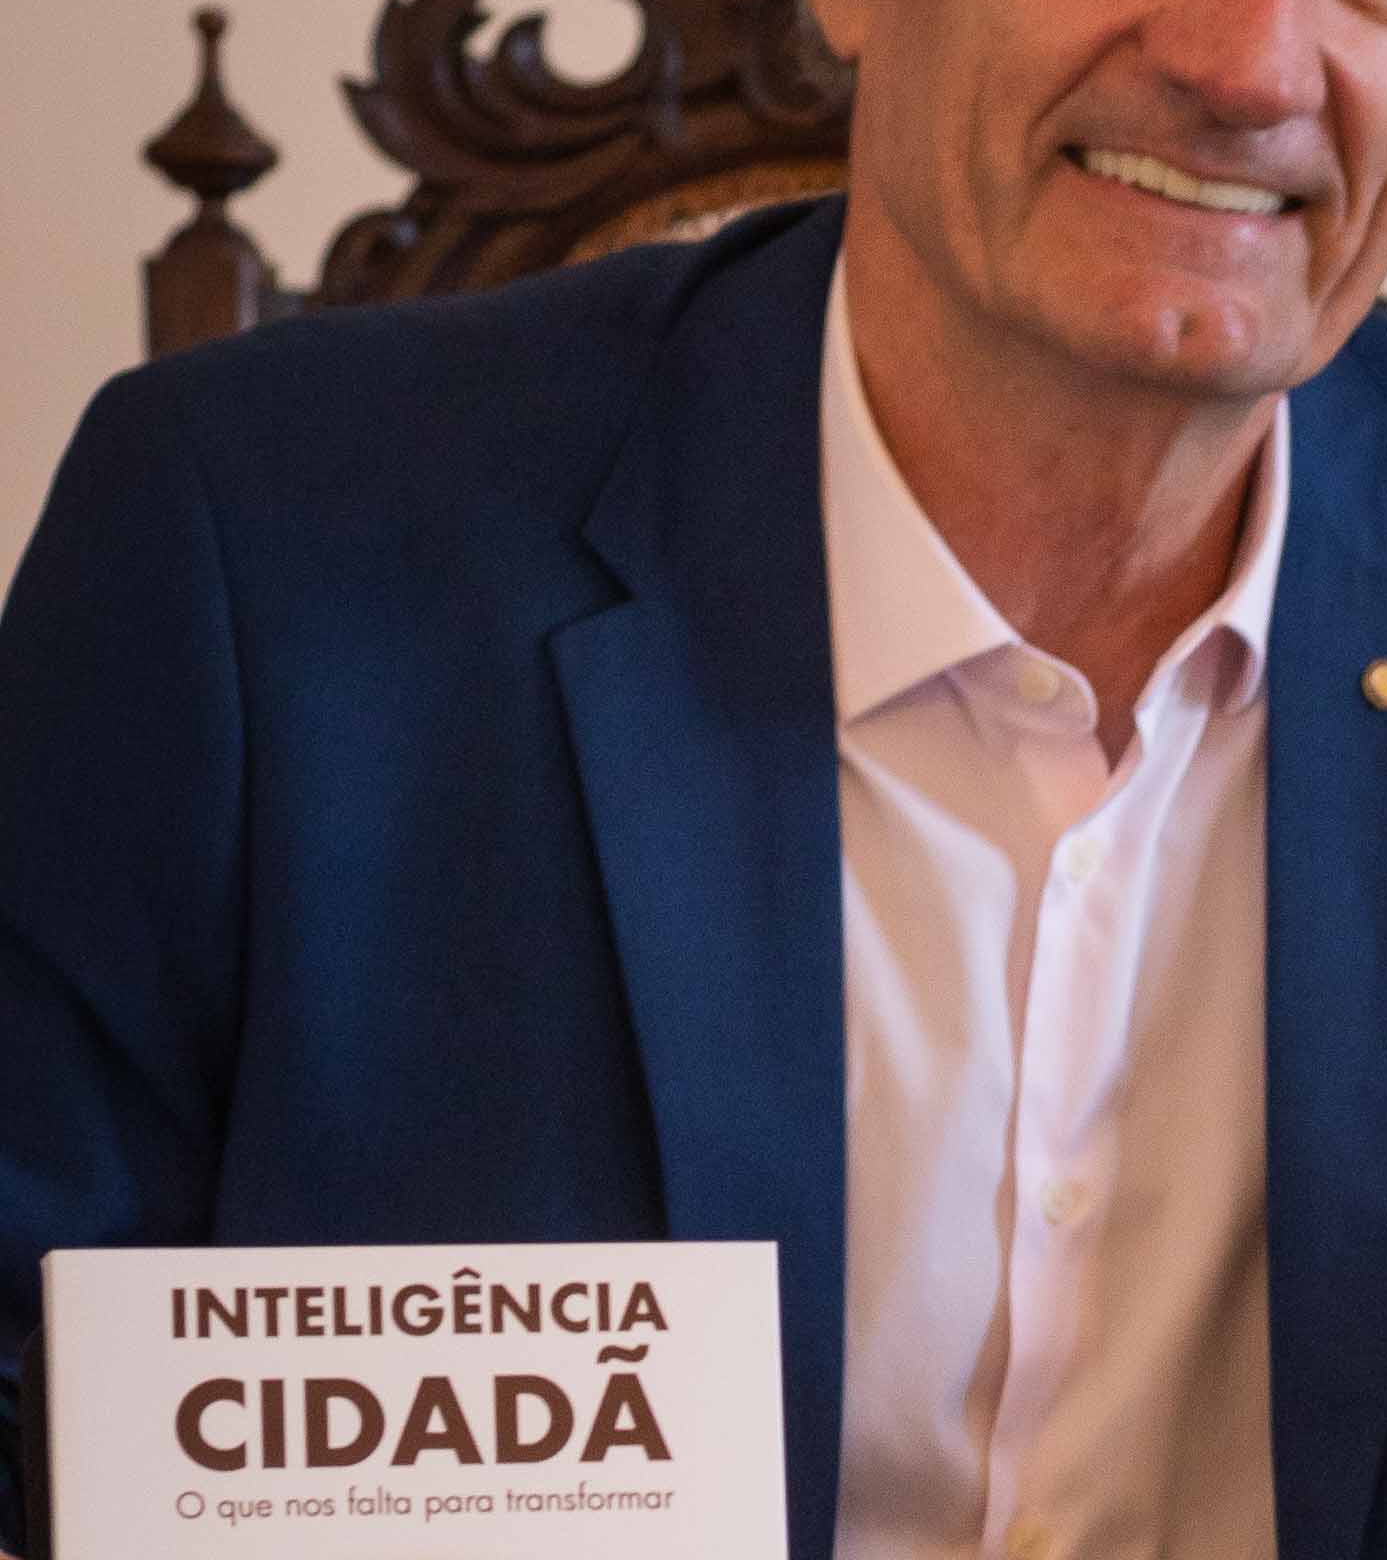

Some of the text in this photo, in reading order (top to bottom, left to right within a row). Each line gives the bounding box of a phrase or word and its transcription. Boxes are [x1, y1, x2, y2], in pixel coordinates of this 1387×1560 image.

[172, 1267, 669, 1338] INTELIGÊNCIA
[175, 1344, 673, 1472] CIDADÃ
[176, 1481, 675, 1527] O que nos falta para transformar
